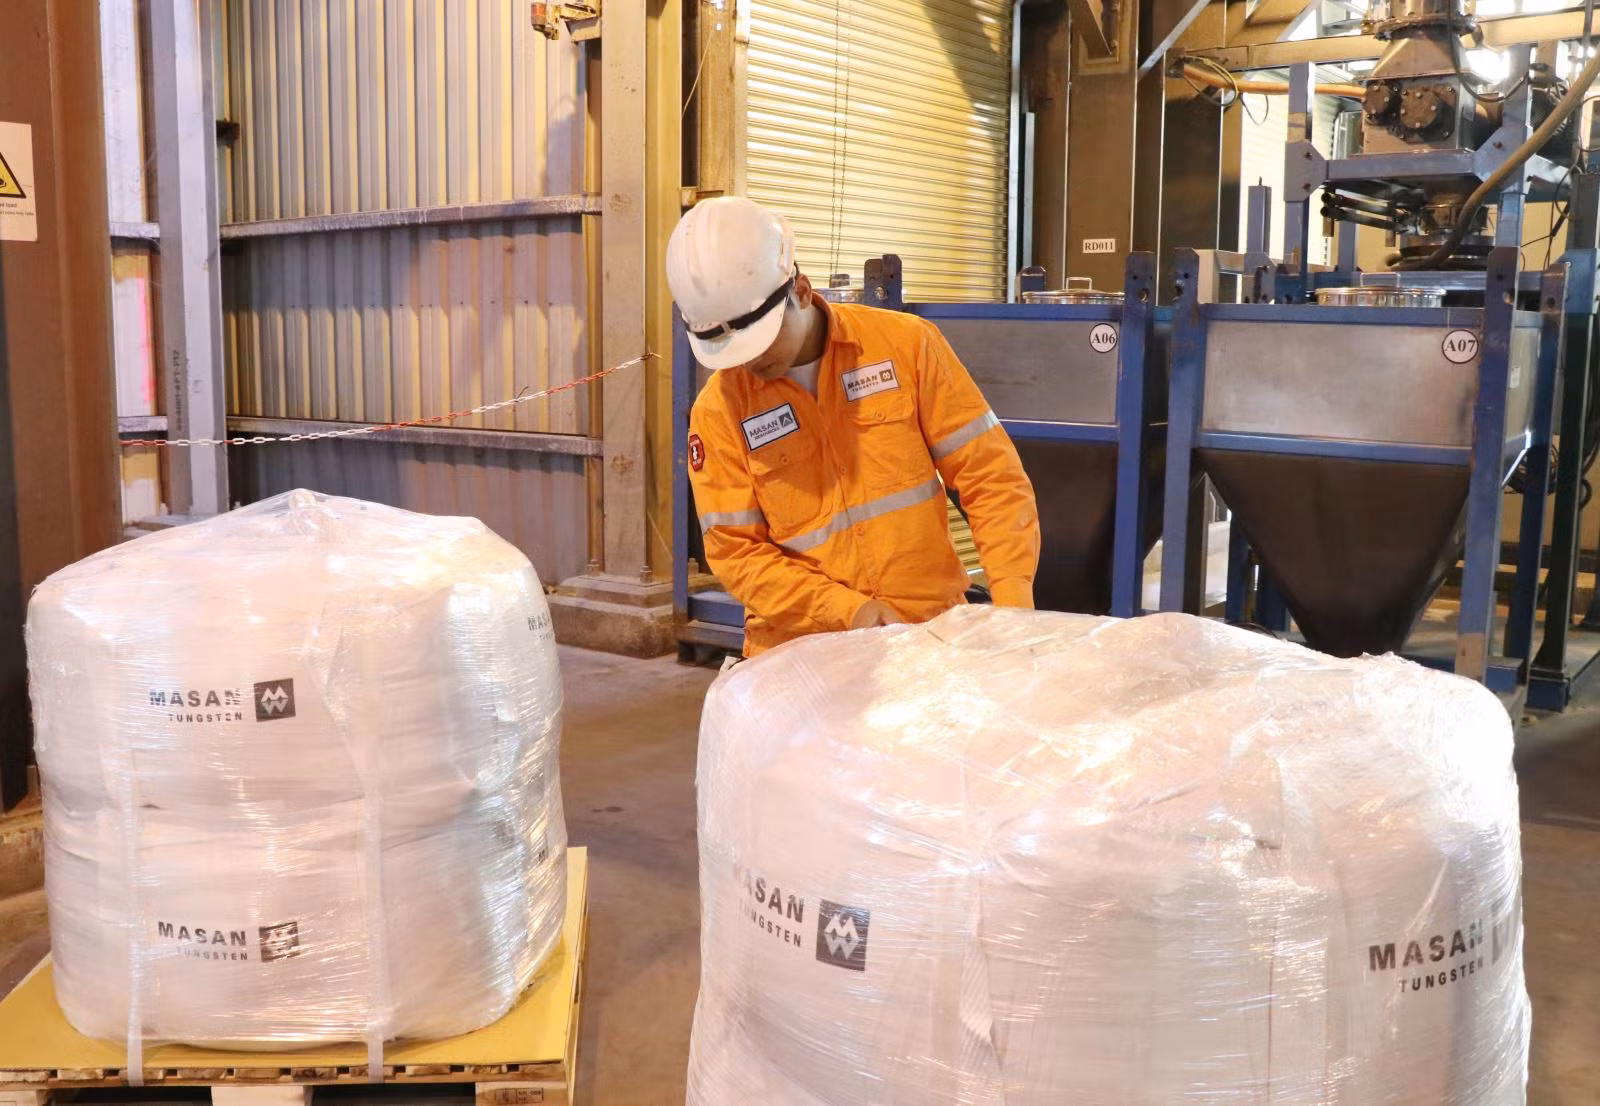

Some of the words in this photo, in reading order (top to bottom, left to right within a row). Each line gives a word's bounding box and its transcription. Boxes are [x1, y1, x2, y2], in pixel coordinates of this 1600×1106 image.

[1084, 241, 1113, 251] RD011
[1091, 332, 1116, 345] A06
[1444, 338, 1476, 353] A07
[847, 374, 878, 390] MASAN
[749, 419, 778, 438] MASAN
[149, 688, 241, 708] MASAN
[168, 711, 242, 723] TUNGSTEN
[158, 920, 247, 946] MASAN
[1399, 956, 1483, 992] TUNGSTEN
